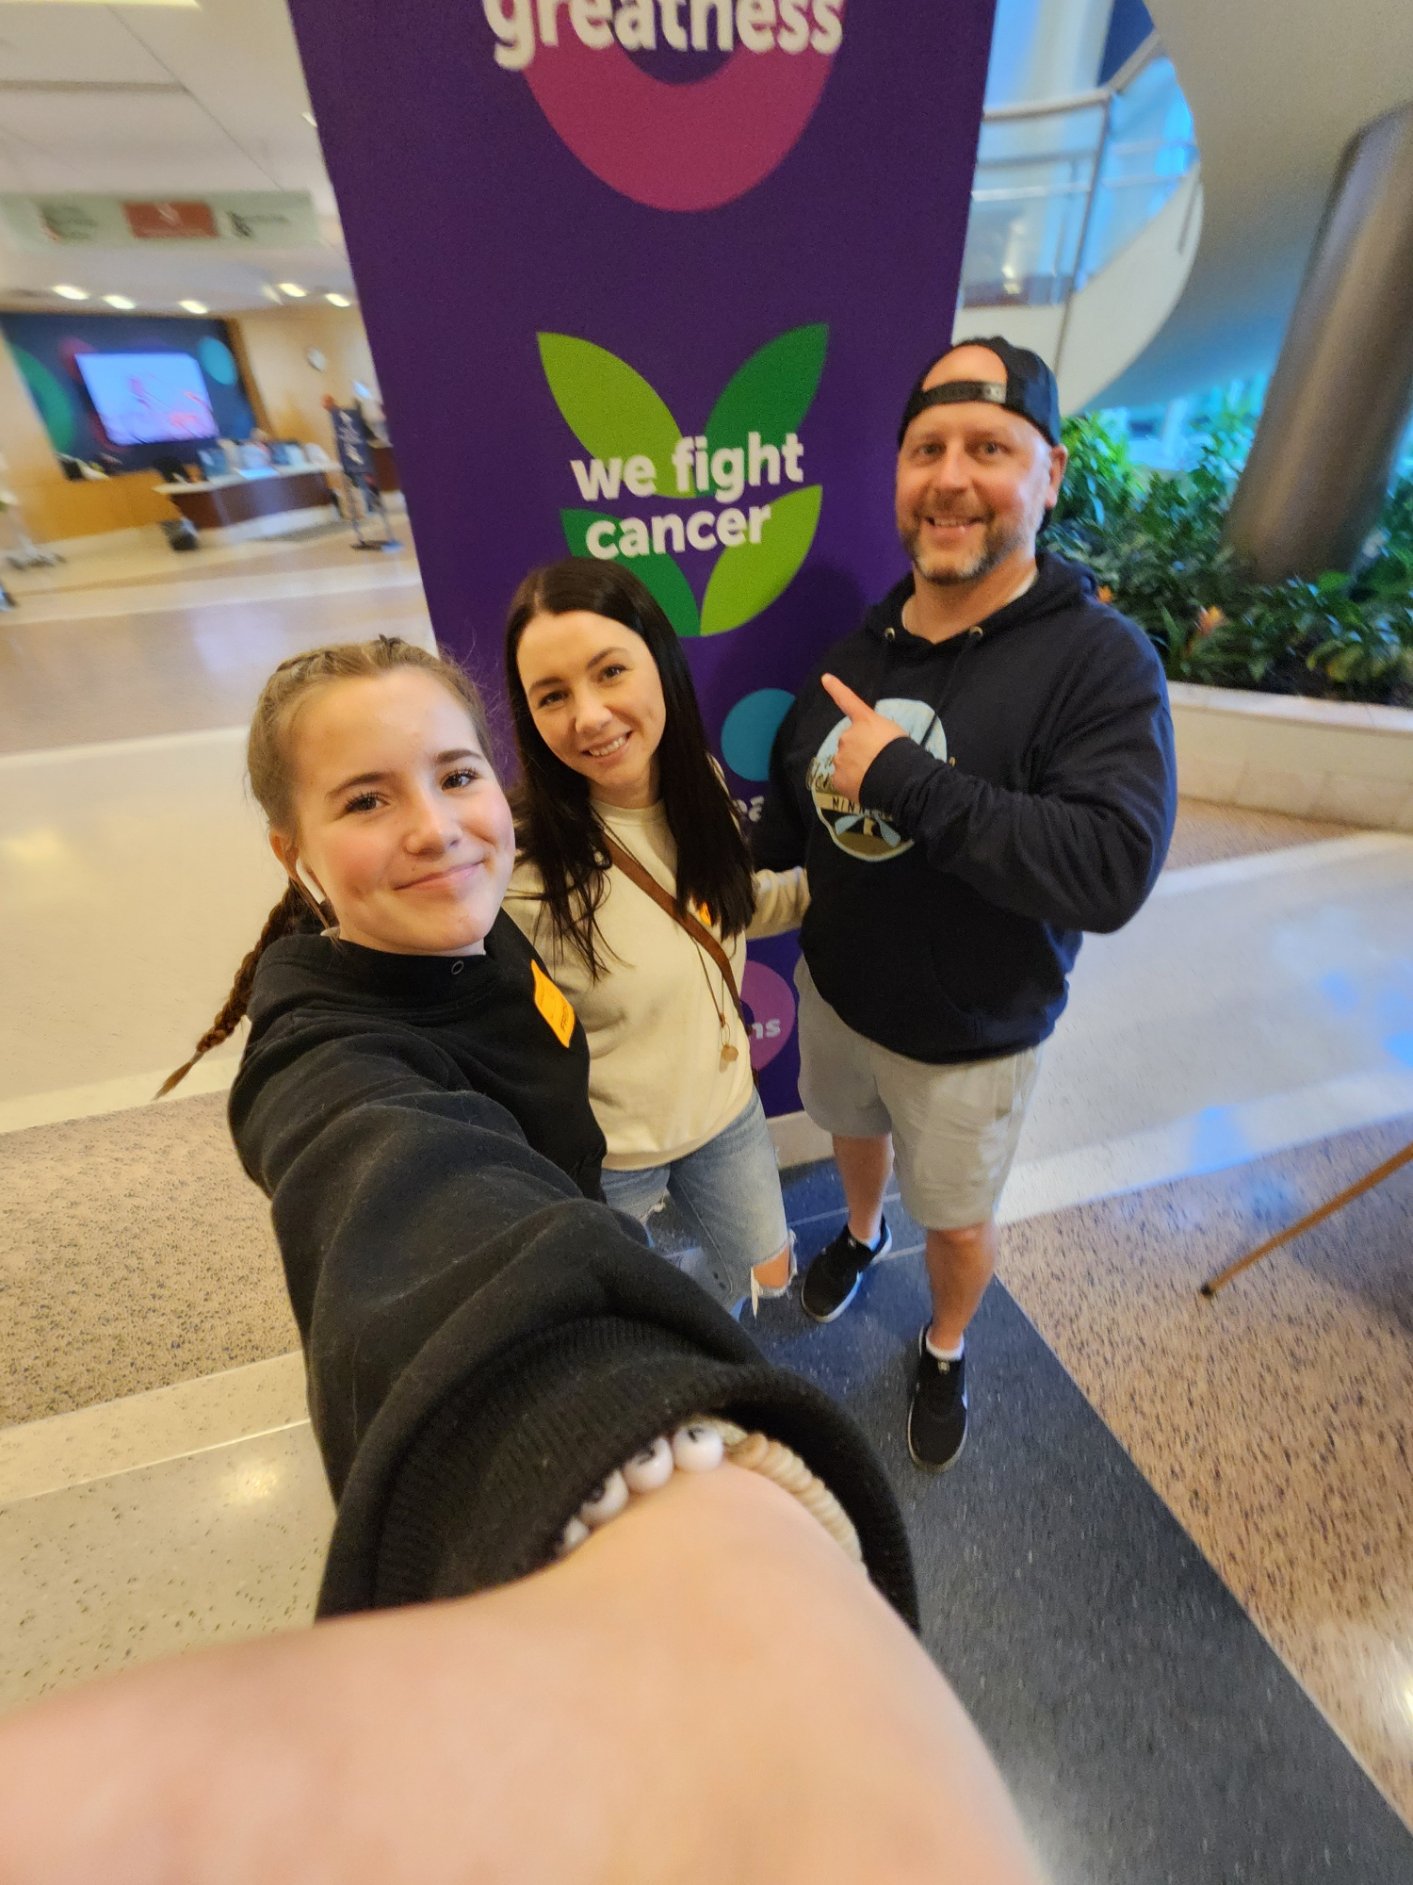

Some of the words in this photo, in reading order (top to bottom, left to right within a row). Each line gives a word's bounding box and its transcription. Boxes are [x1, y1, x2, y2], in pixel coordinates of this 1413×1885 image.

[484, 0, 843, 71] greatness
[570, 454, 657, 501] we
[671, 431, 805, 503] fight
[585, 504, 772, 560] cancer
